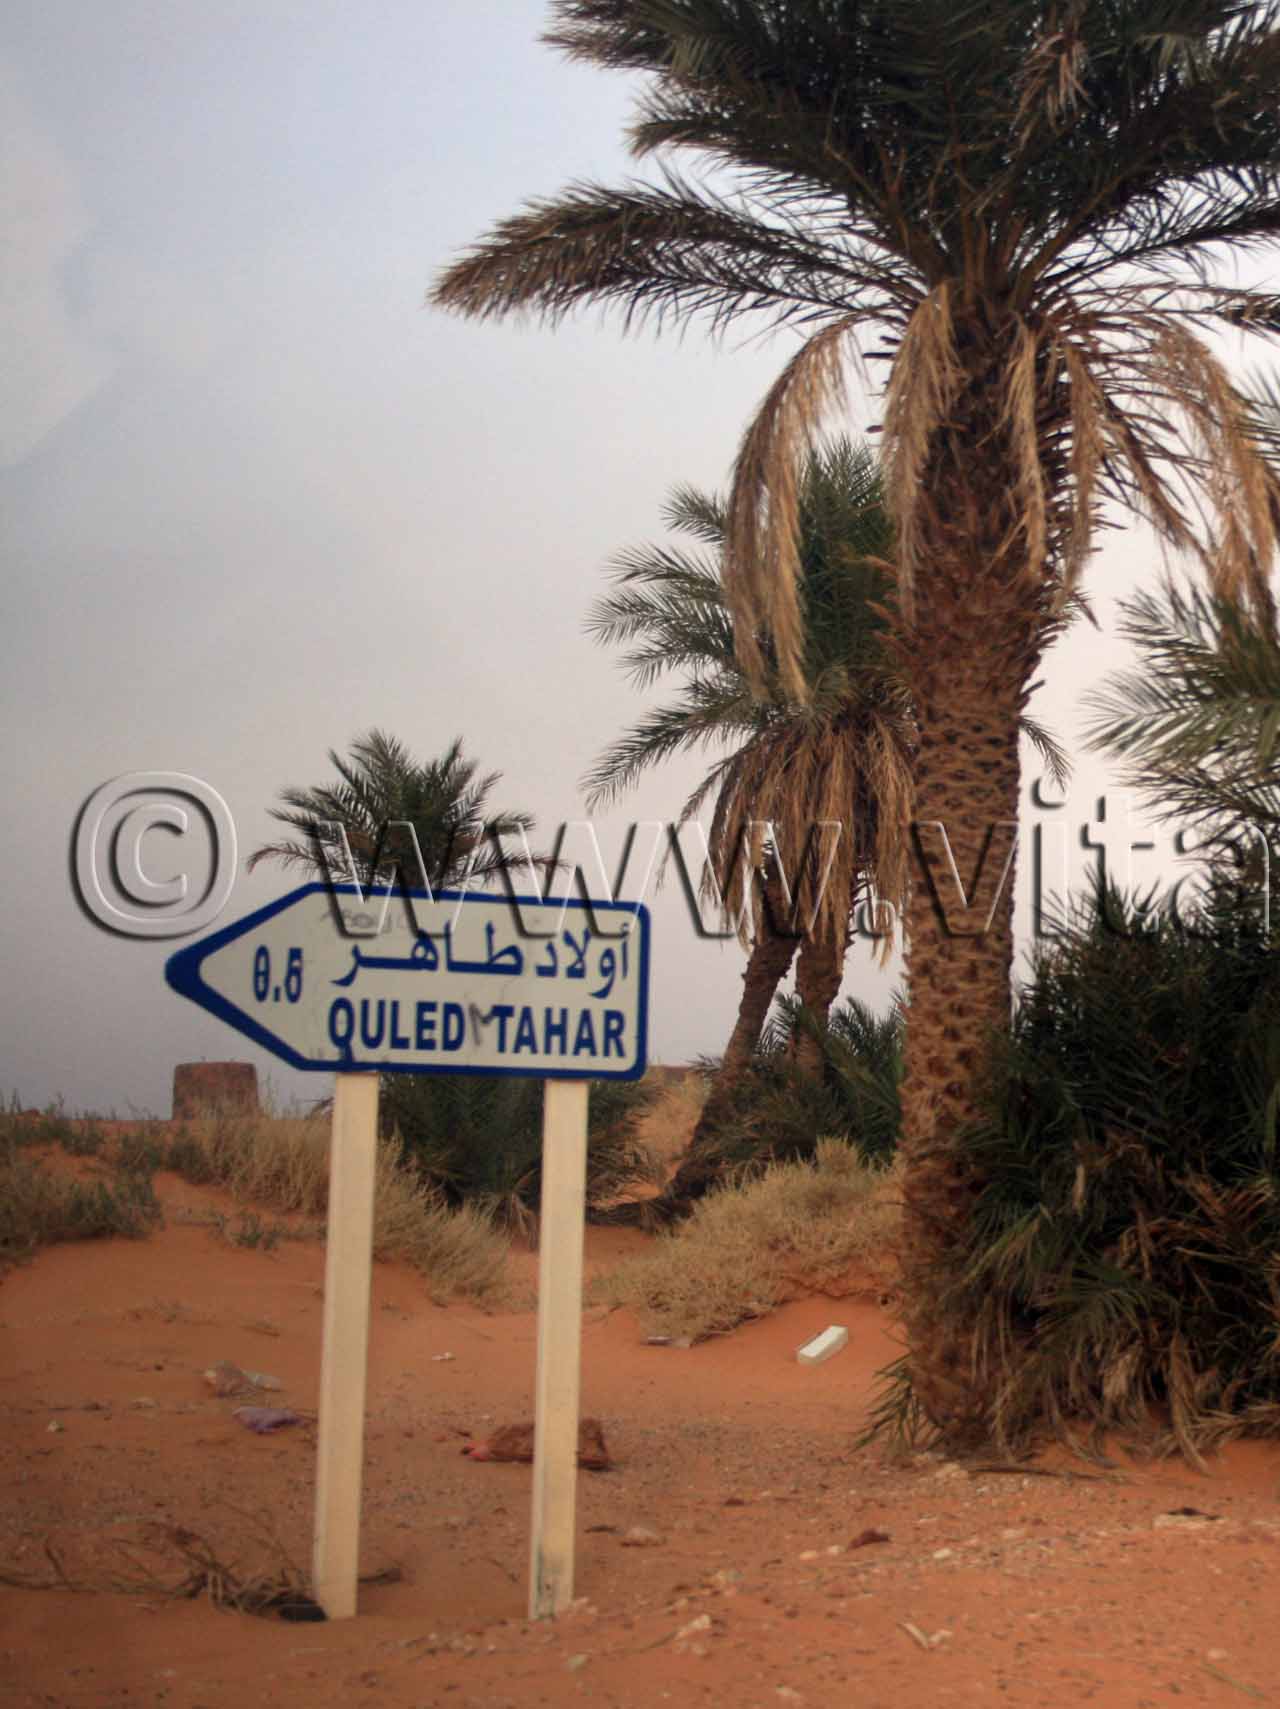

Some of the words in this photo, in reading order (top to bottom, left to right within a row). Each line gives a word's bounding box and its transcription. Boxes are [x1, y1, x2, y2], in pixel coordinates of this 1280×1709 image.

[330, 920, 525, 987] طاهر
[536, 922, 630, 999] أولاد
[491, 1003, 626, 1058] TAHAR
